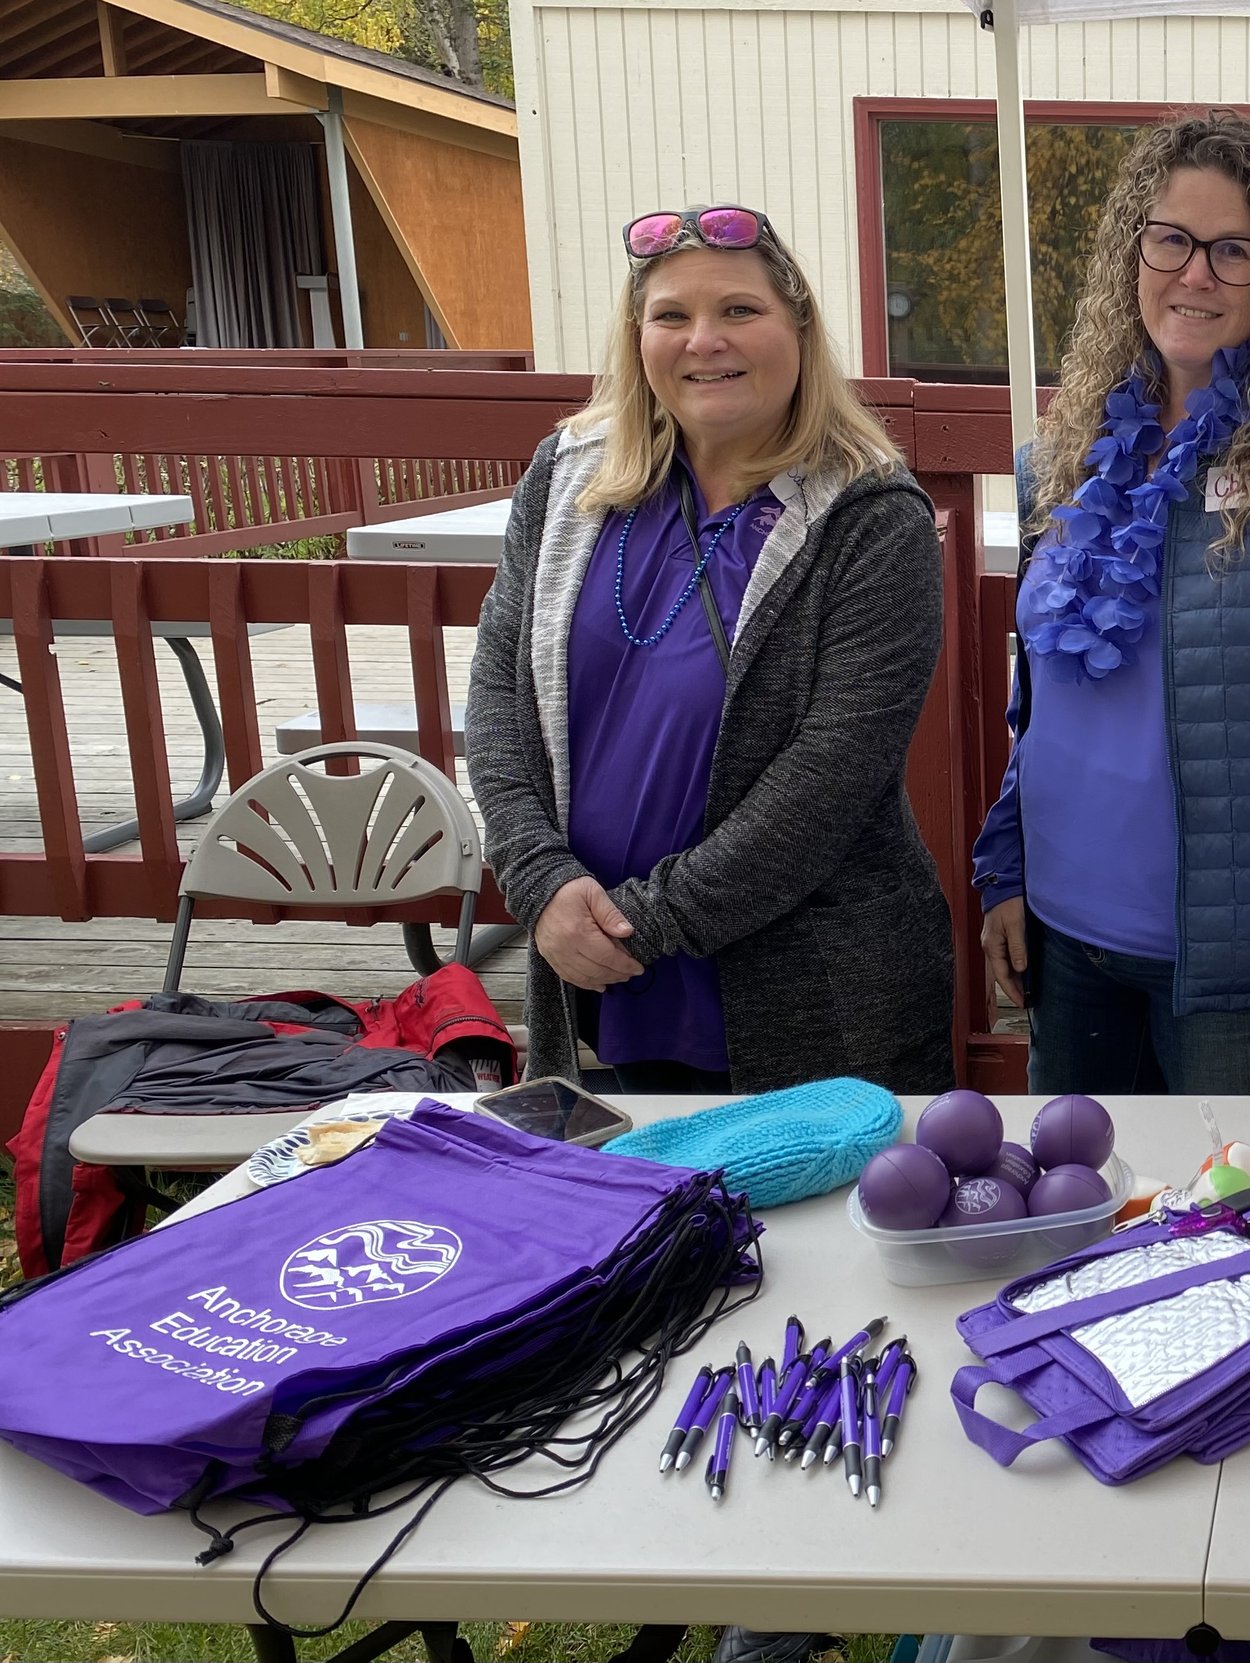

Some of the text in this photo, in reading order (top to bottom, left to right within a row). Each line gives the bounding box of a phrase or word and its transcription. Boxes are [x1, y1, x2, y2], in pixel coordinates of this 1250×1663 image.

[149, 1310, 298, 1365] Education
[187, 1285, 348, 1348] Anchorage
[89, 1326, 265, 1397] Association
